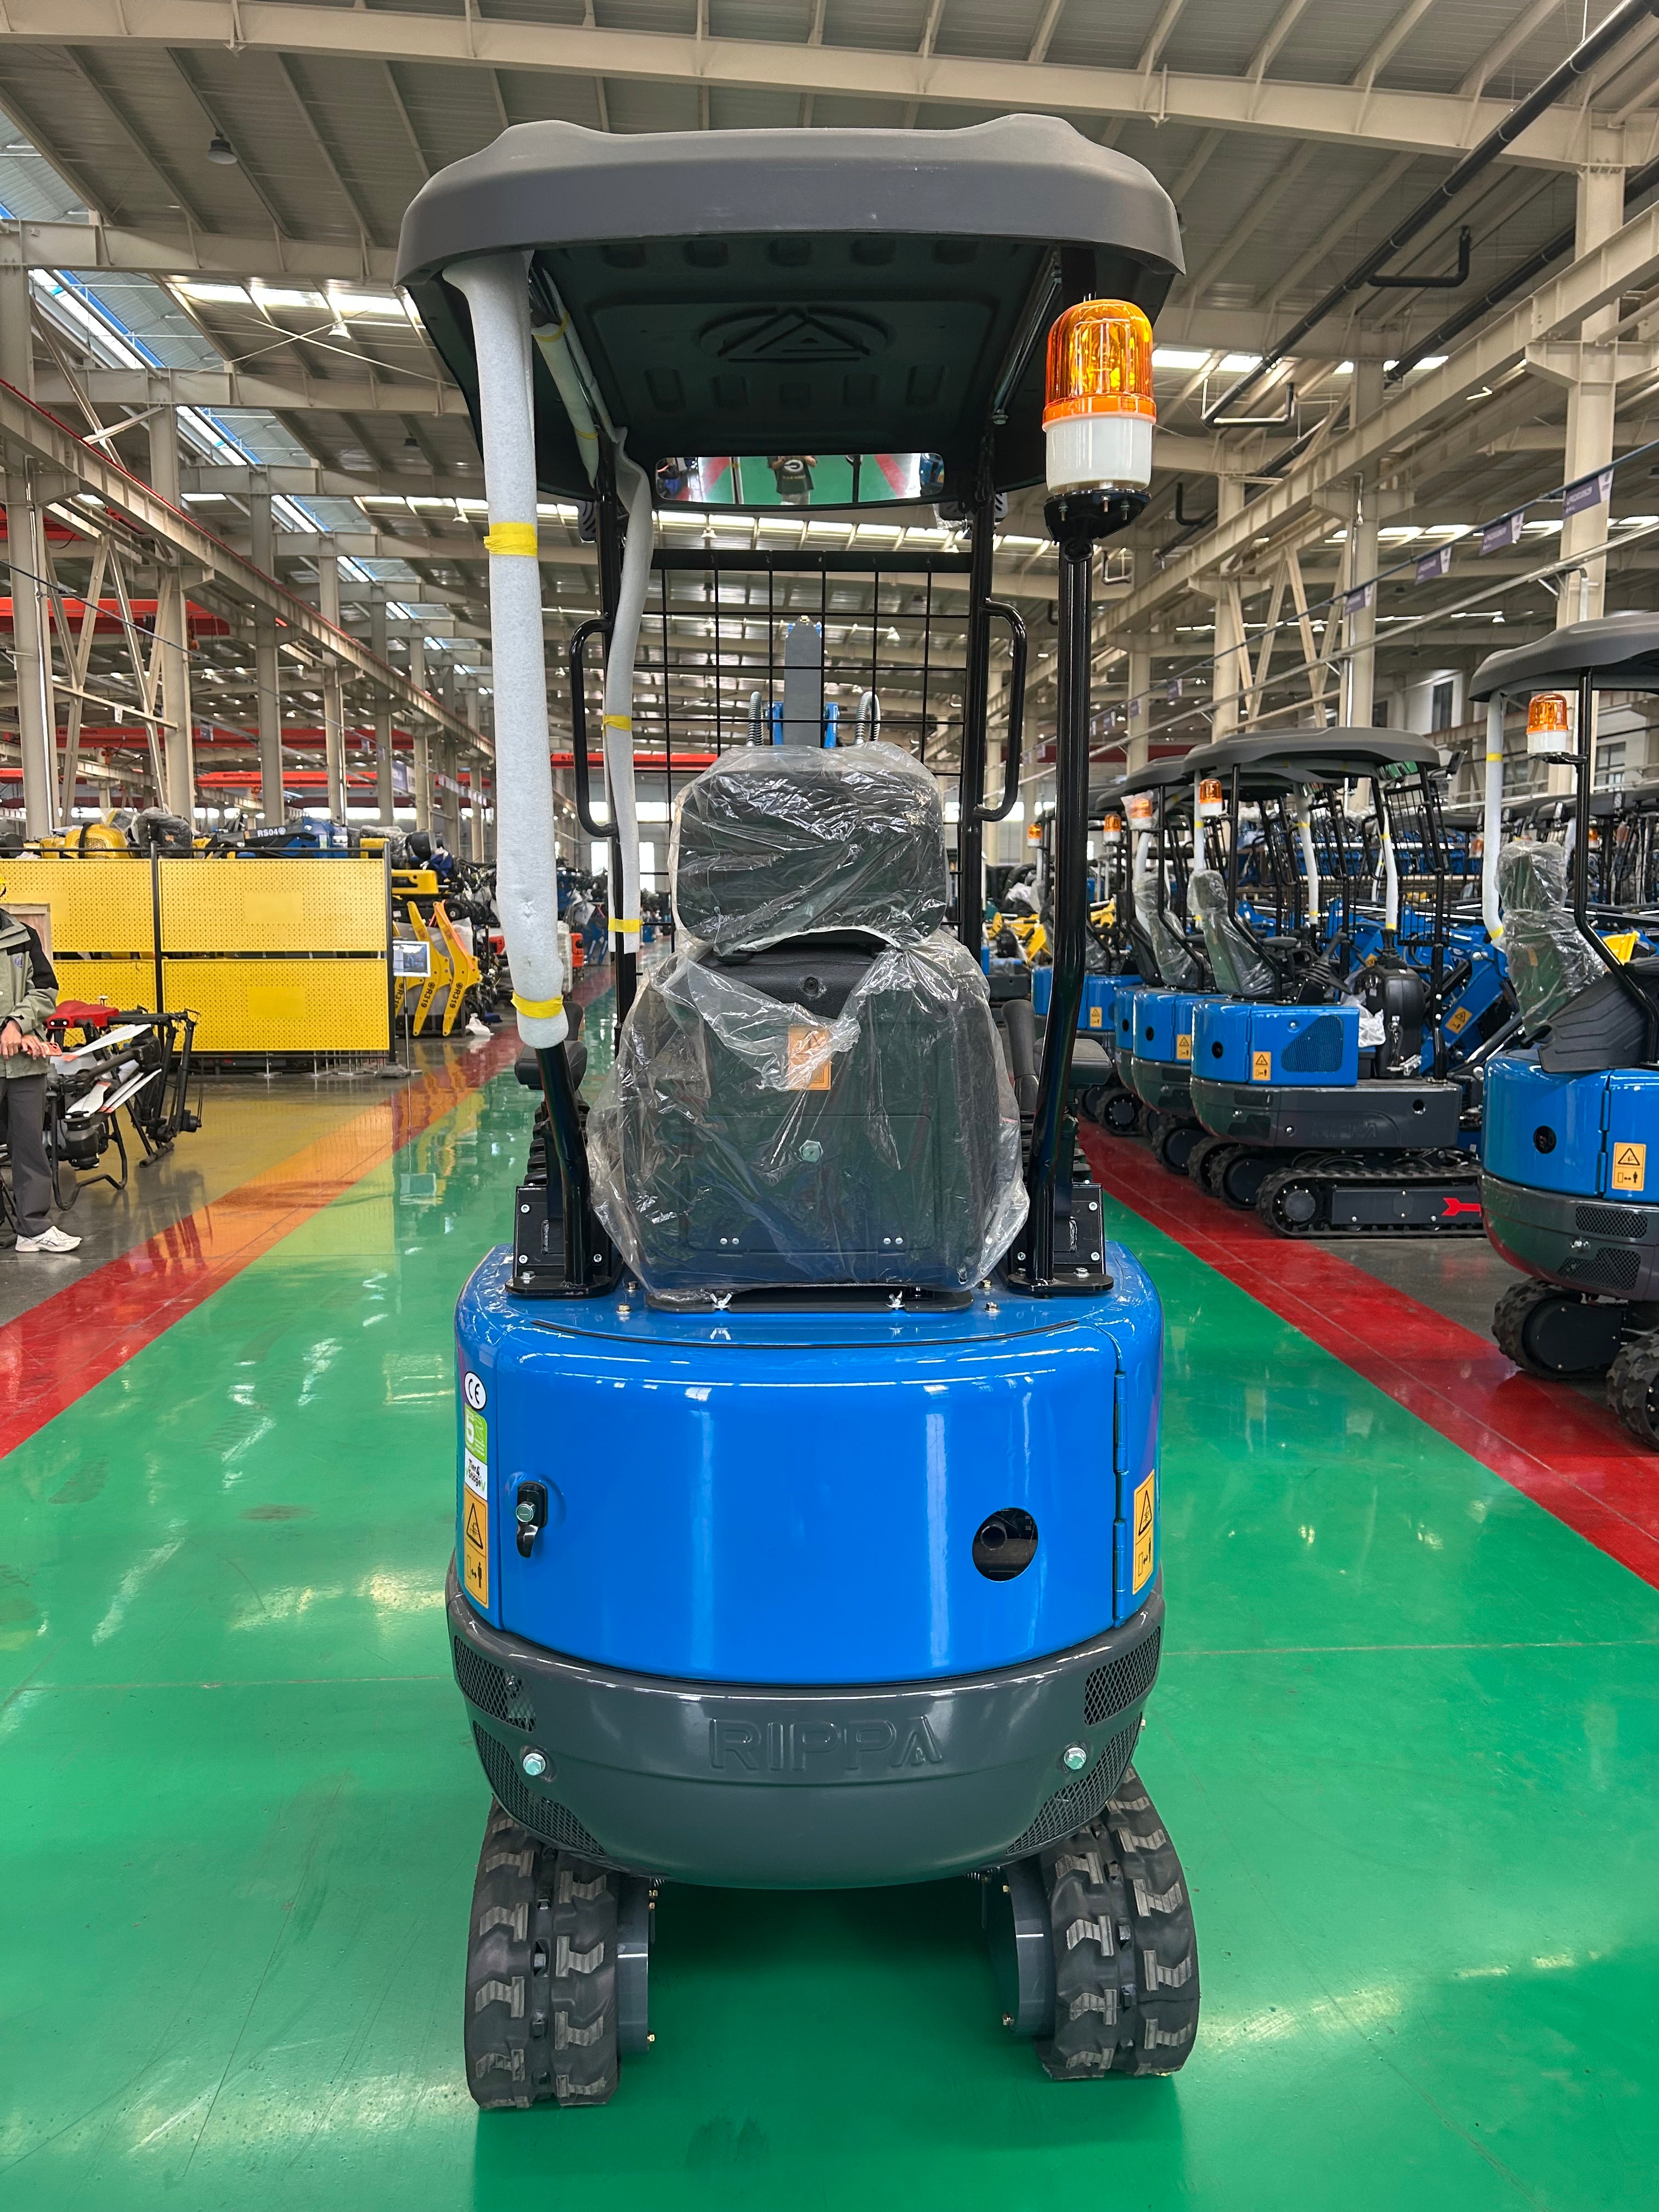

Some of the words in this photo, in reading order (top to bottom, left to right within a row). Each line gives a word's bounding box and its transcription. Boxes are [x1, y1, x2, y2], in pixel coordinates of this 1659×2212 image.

[257, 828, 278, 837] RS04
[421, 988, 433, 1008] R319
[449, 989, 461, 1008] R319
[469, 1379, 480, 1404] CE
[469, 1468, 482, 1487] Stage
[709, 1715, 943, 1771] RIPPA
